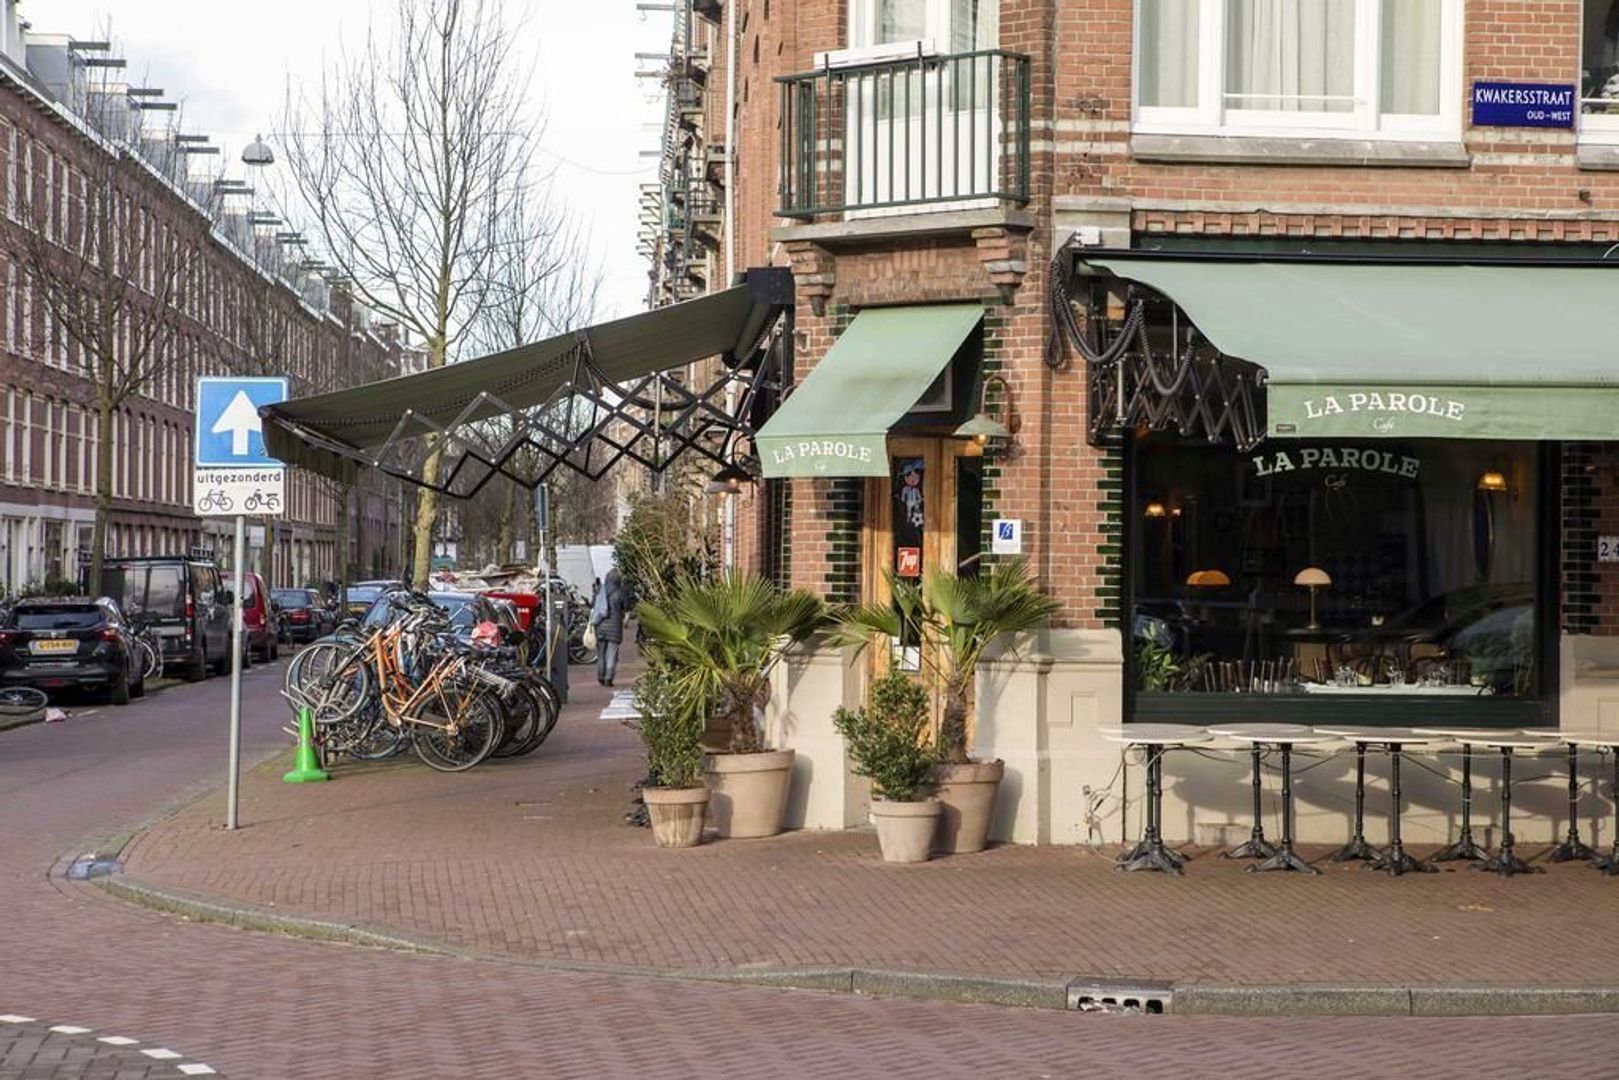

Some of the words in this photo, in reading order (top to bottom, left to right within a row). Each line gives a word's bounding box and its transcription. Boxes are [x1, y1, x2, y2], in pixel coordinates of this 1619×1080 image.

[1475, 88, 1572, 105] KWAKERSSTRAAT
[1304, 396, 1344, 419] LA
[1349, 392, 1465, 421] PAROLE
[773, 445, 795, 464] LA
[798, 441, 871, 462] PAROLE
[1252, 451, 1295, 476] LA
[1300, 447, 1420, 479] PAROLE
[197, 472, 281, 485] uitgezonderd
